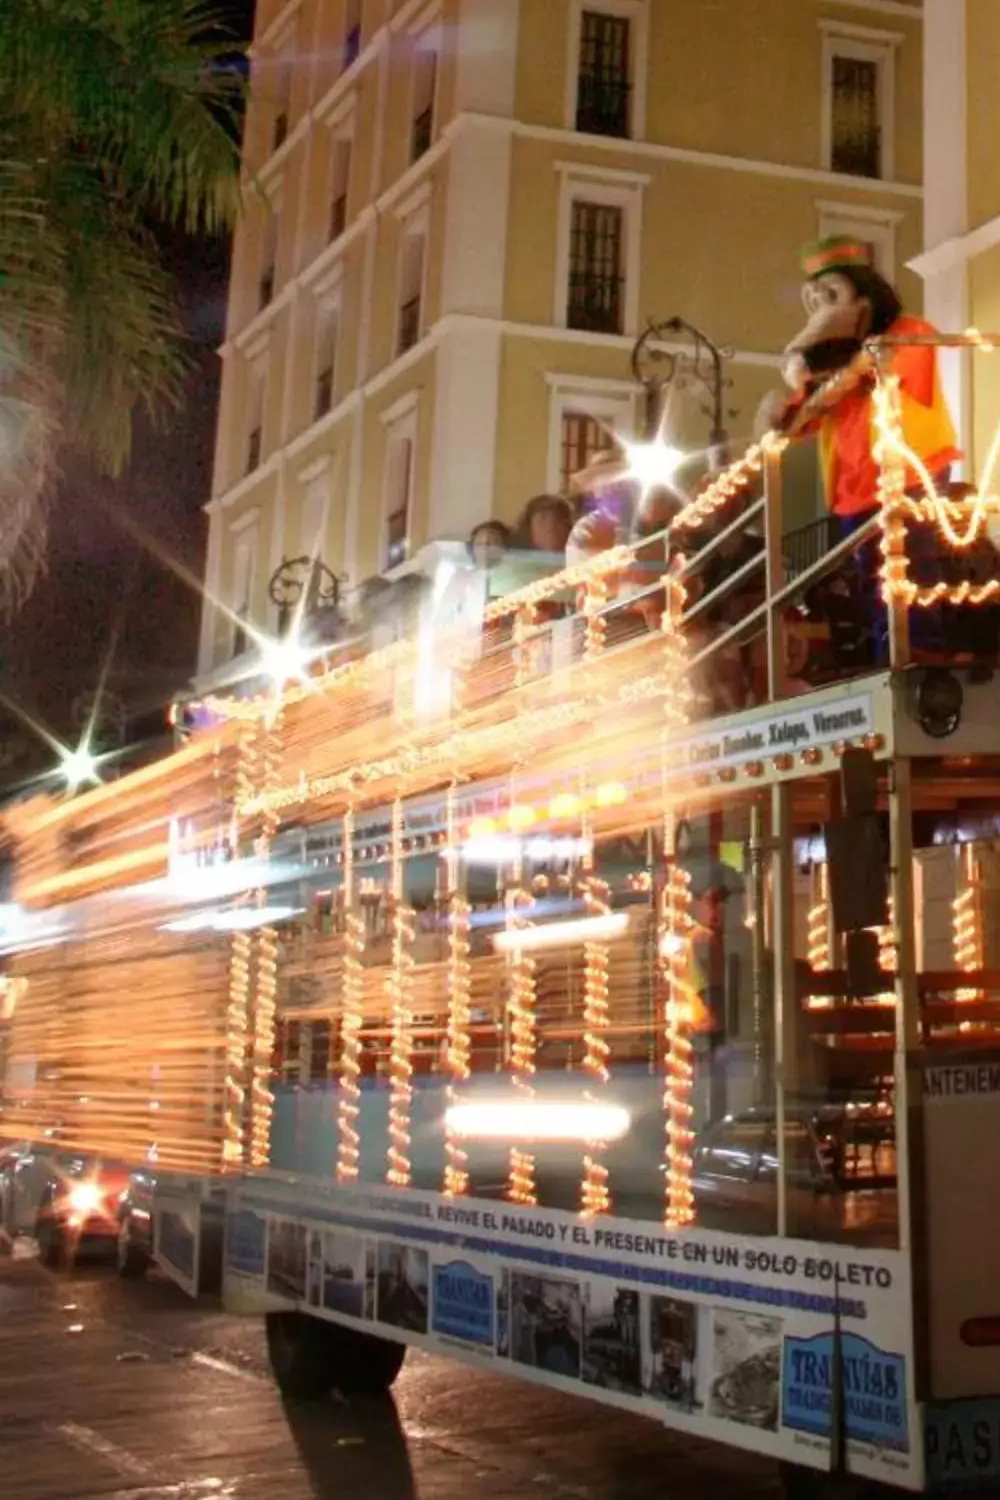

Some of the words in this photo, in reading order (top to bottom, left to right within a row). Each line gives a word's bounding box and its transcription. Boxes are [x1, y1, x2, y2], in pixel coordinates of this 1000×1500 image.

[437, 1203, 480, 1227] REVIVE
[483, 1212, 499, 1231] EL
[502, 1215, 555, 1240] PASADO
[558, 1224, 568, 1242] Y
[572, 1227, 590, 1245] EL
[594, 1227, 677, 1259] PRESENTE
[684, 1241, 707, 1265] EN
[712, 1246, 739, 1268] UN
[744, 1250, 797, 1276] SOLO
[804, 1258, 892, 1289] BOLETO
